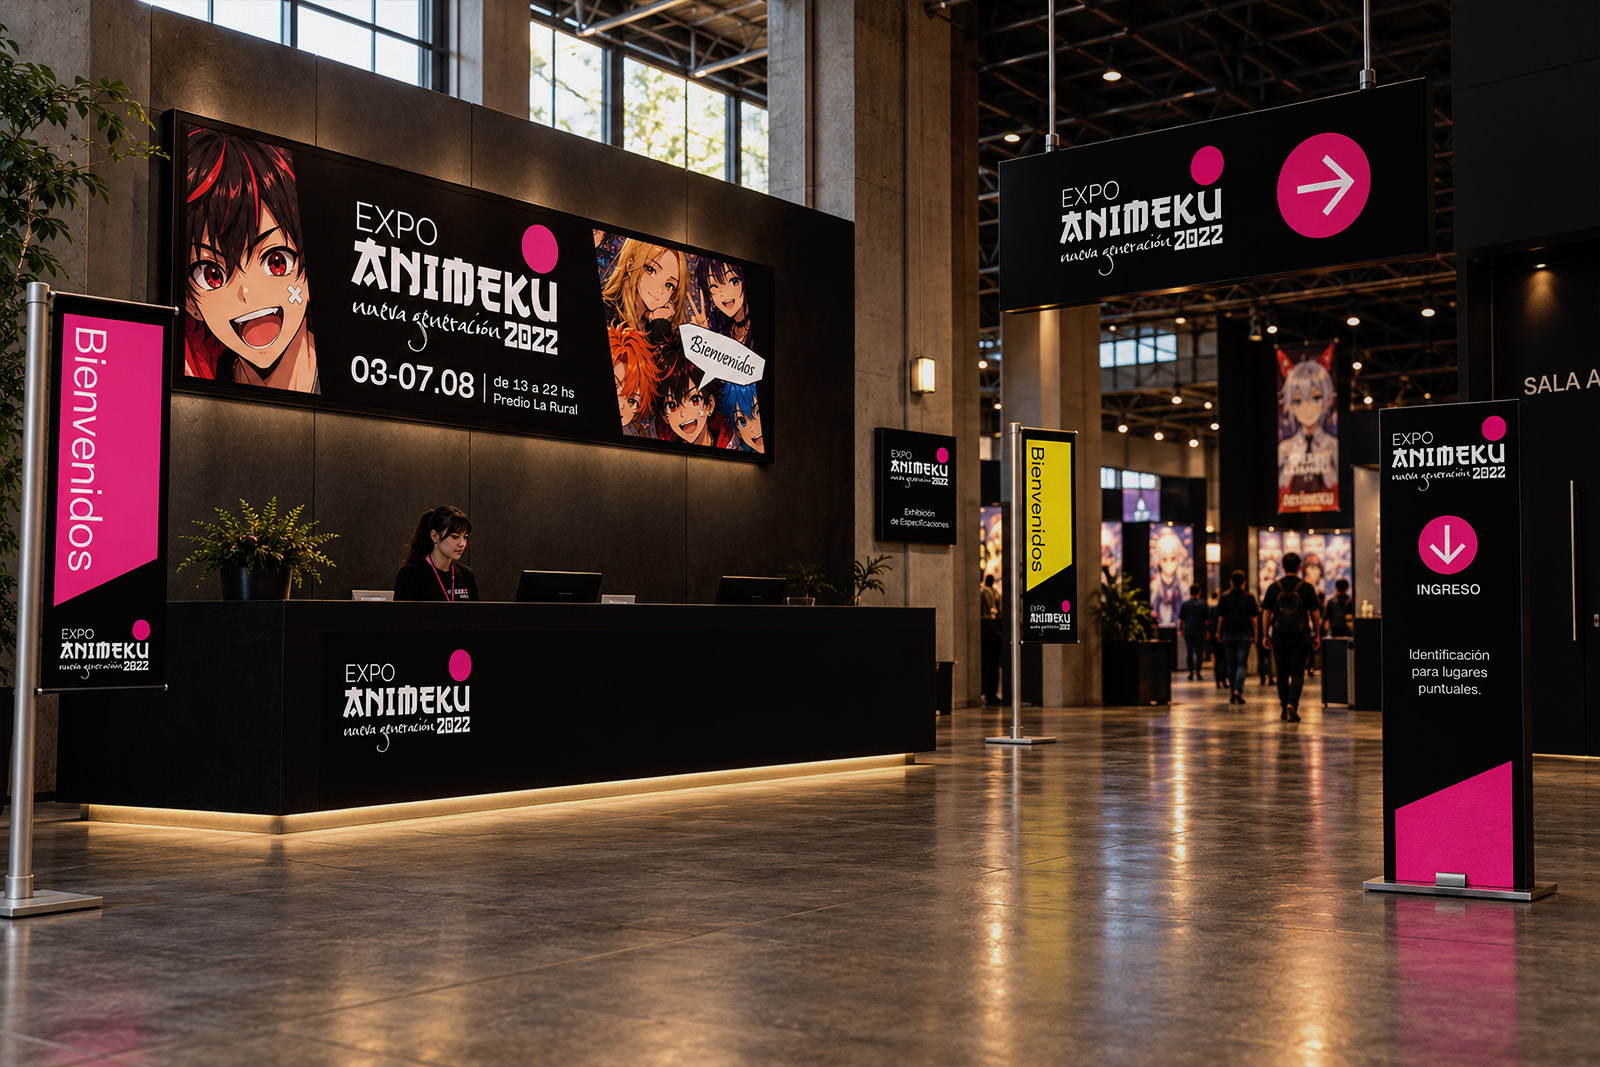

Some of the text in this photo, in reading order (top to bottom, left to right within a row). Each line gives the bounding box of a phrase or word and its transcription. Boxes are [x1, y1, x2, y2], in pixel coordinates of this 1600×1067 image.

[1062, 180, 1120, 208] EXPO
[356, 200, 438, 247] EXPO
[1059, 188, 1222, 244] ANIMEKU
[1098, 234, 1173, 276] generación
[1174, 224, 1223, 251] 2022
[351, 237, 558, 323] ANIMEKU
[352, 301, 559, 355] nueva generación 2022
[690, 335, 756, 376] Bienvenidos
[351, 355, 475, 399] 03-07.08
[493, 375, 575, 399] de 13 a 22 hs
[1523, 368, 1600, 396] SALA A
[493, 393, 578, 415] Predio La Rural
[67, 326, 107, 573] Bienvenidos
[1392, 431, 1434, 446] EXPO
[890, 449, 912, 460] EXPO
[1391, 443, 1505, 468] ANIMEKU
[890, 459, 948, 477] ANIMEKU
[1472, 466, 1506, 480] 2022
[1031, 446, 1046, 572] Bienvenidos
[890, 518, 899, 526] de
[1416, 583, 1481, 596] INGRESO
[1030, 613, 1071, 623] ANIMEKU
[61, 628, 95, 640] EXPO
[60, 641, 149, 659] ANIMEKU
[1409, 648, 1490, 661] Identificación
[345, 663, 395, 683] EXPO
[1411, 666, 1488, 679] para lugares
[342, 685, 470, 718] ANIMEKU
[1418, 683, 1482, 697] puntuales.
[376, 717, 435, 753] generación
[436, 716, 471, 734] 2022
